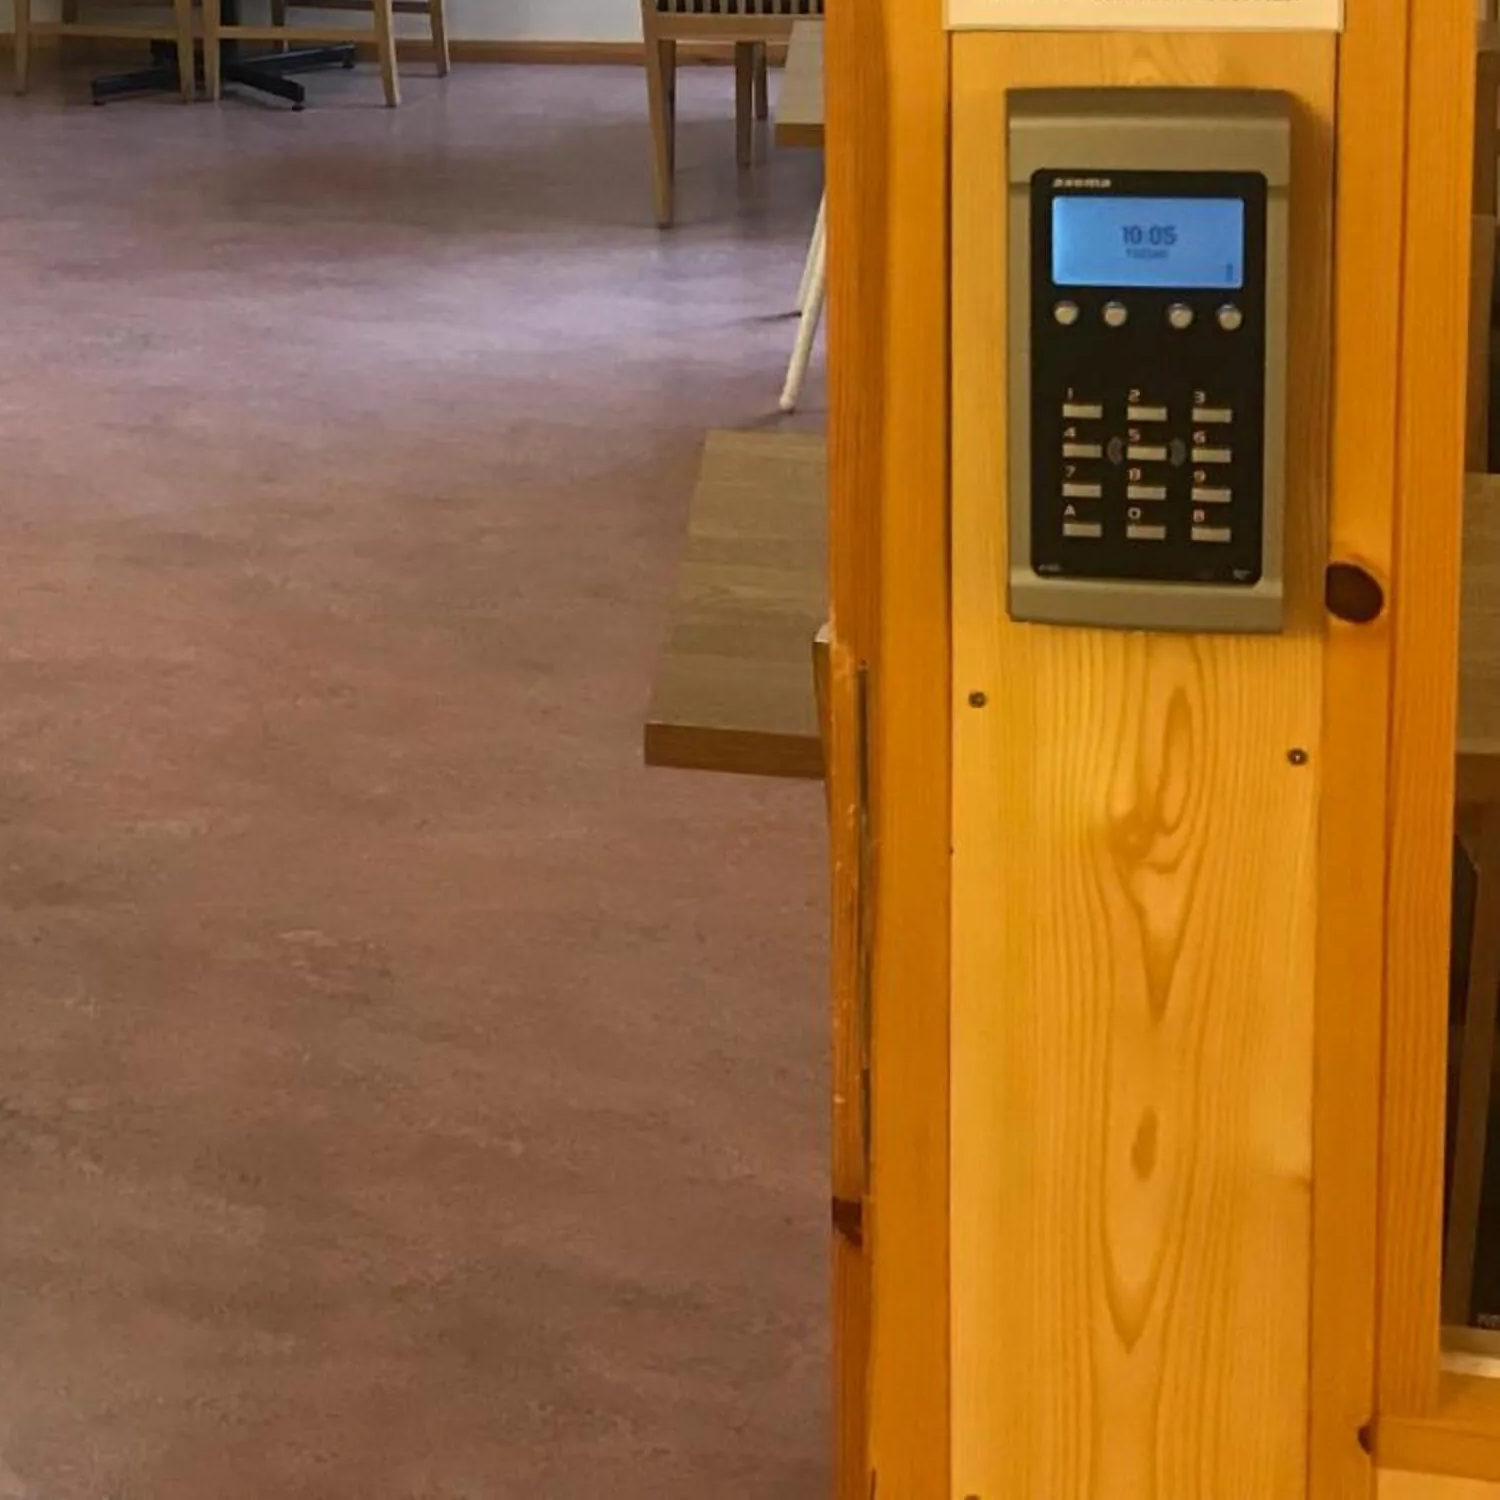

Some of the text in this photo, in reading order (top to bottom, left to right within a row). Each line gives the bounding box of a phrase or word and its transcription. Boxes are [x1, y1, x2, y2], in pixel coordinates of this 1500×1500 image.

[1129, 388, 1141, 403] 2
[1193, 390, 1206, 405] 3
[1063, 426, 1077, 438] 4
[1127, 427, 1141, 442] 5
[1064, 464, 1076, 479] 7
[1063, 503, 1077, 517] A
